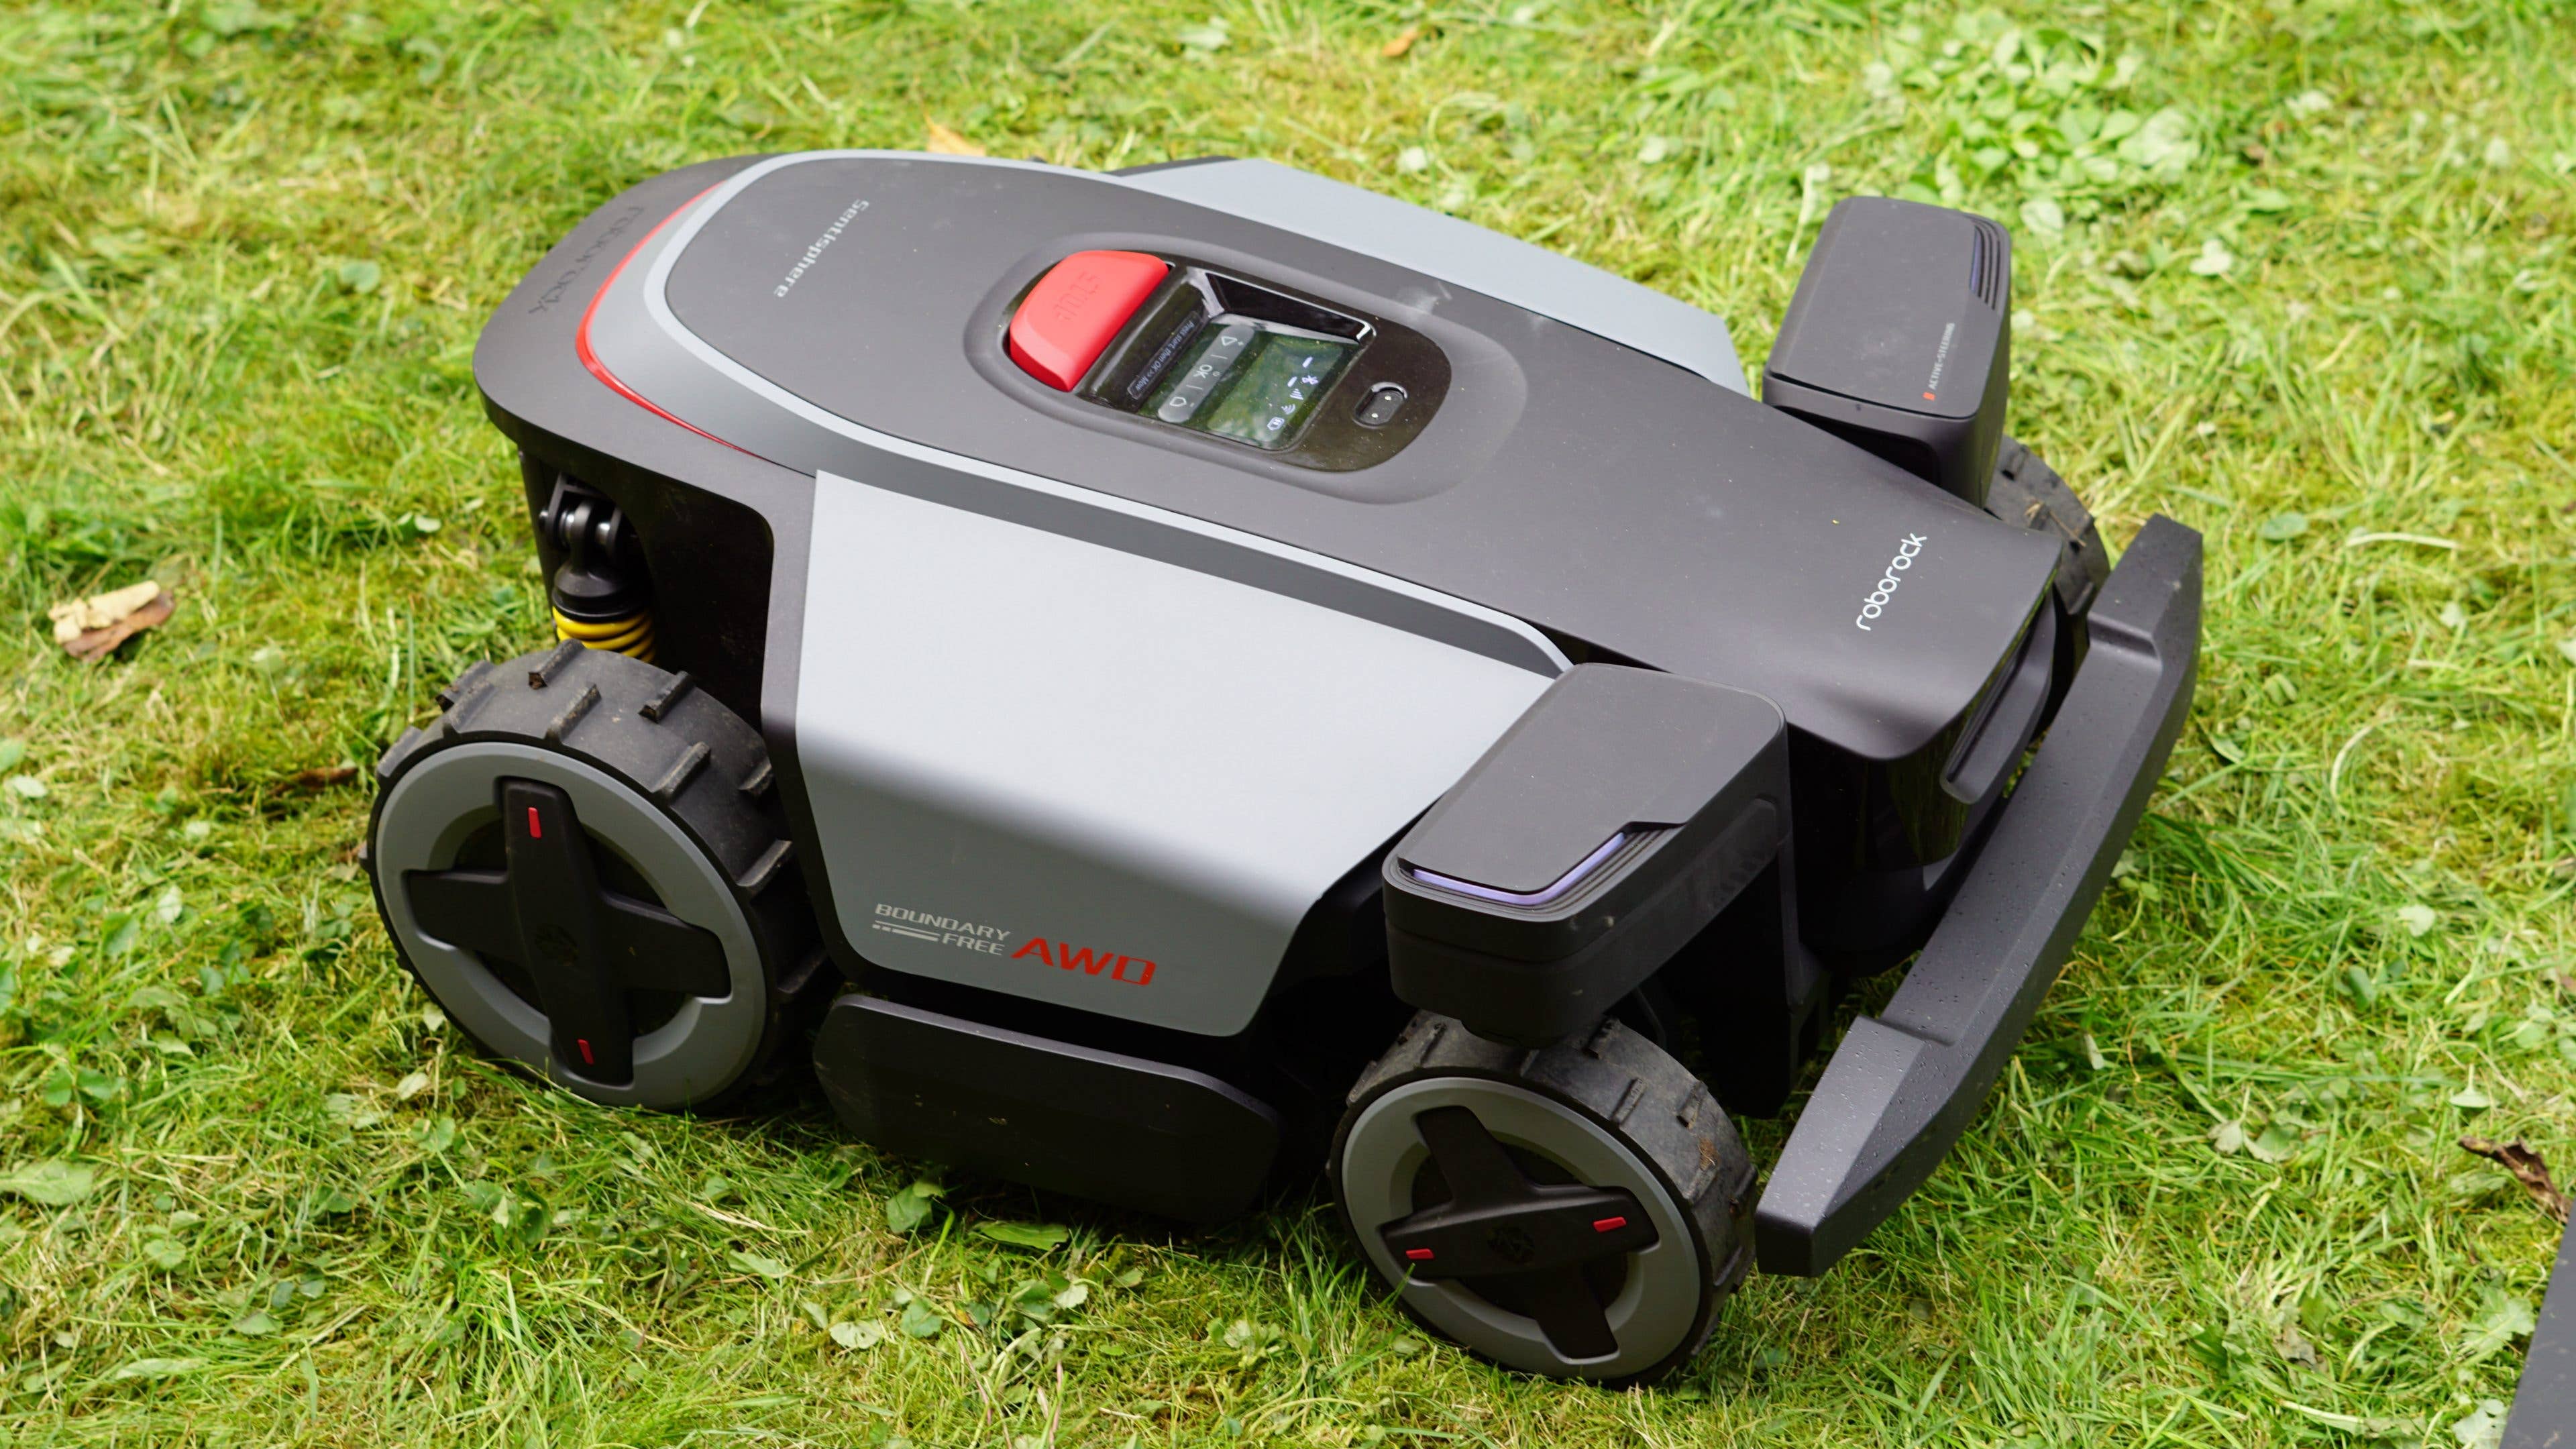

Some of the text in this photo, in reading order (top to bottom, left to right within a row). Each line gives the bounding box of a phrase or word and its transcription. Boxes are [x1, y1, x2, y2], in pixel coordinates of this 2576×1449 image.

[772, 199, 869, 299] Sentisphere
[1179, 320, 1195, 337] Press
[1193, 363, 1213, 379] OK
[1856, 533, 1927, 631] roborock
[875, 903, 1010, 941] BOUNDARY
[942, 933, 1005, 955] FREE
[1012, 937, 1157, 985] AWD
